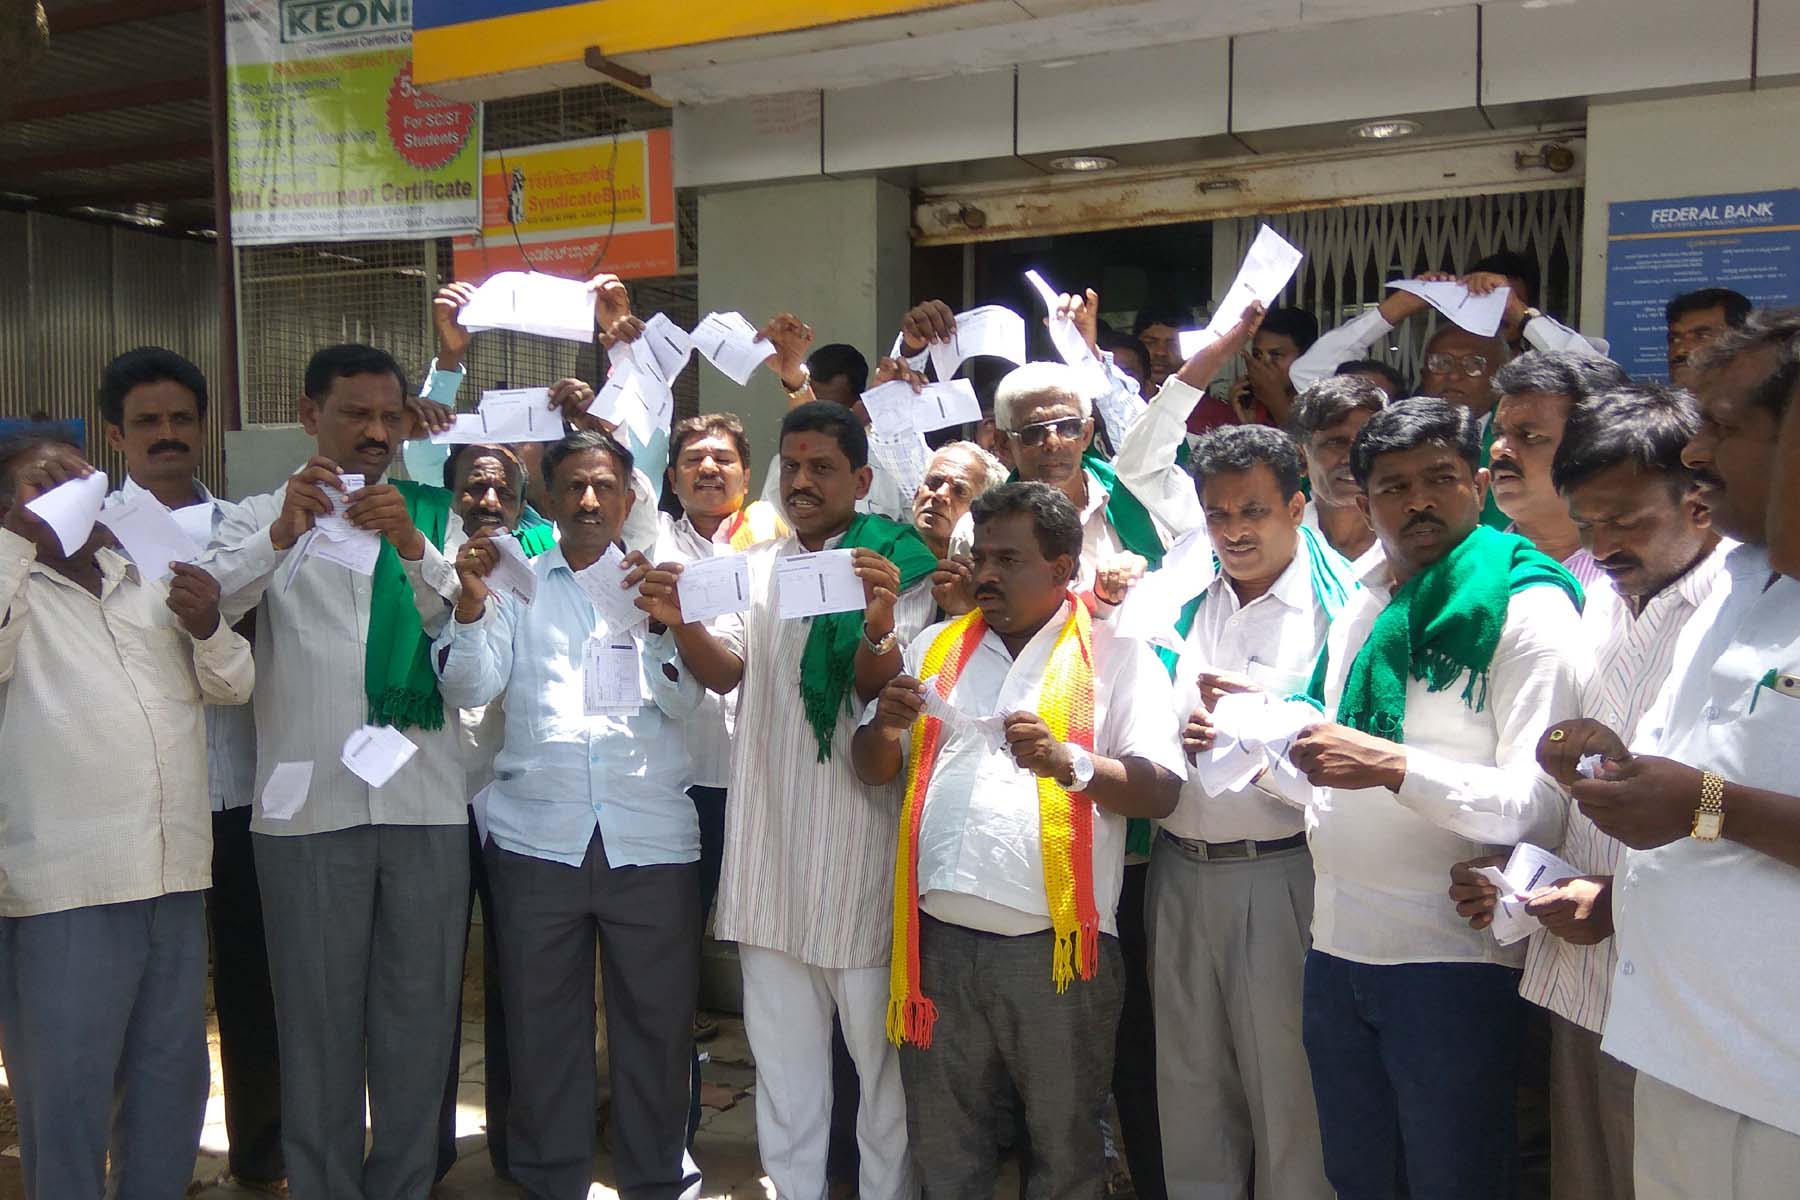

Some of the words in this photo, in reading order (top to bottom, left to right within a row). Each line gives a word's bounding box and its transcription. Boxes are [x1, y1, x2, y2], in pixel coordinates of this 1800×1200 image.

[403, 131, 459, 147] Students
[268, 185, 375, 208] Government
[380, 178, 472, 203] Certificate
[1650, 205, 1720, 224] FEDERAL
[1723, 201, 1774, 219] BANK
